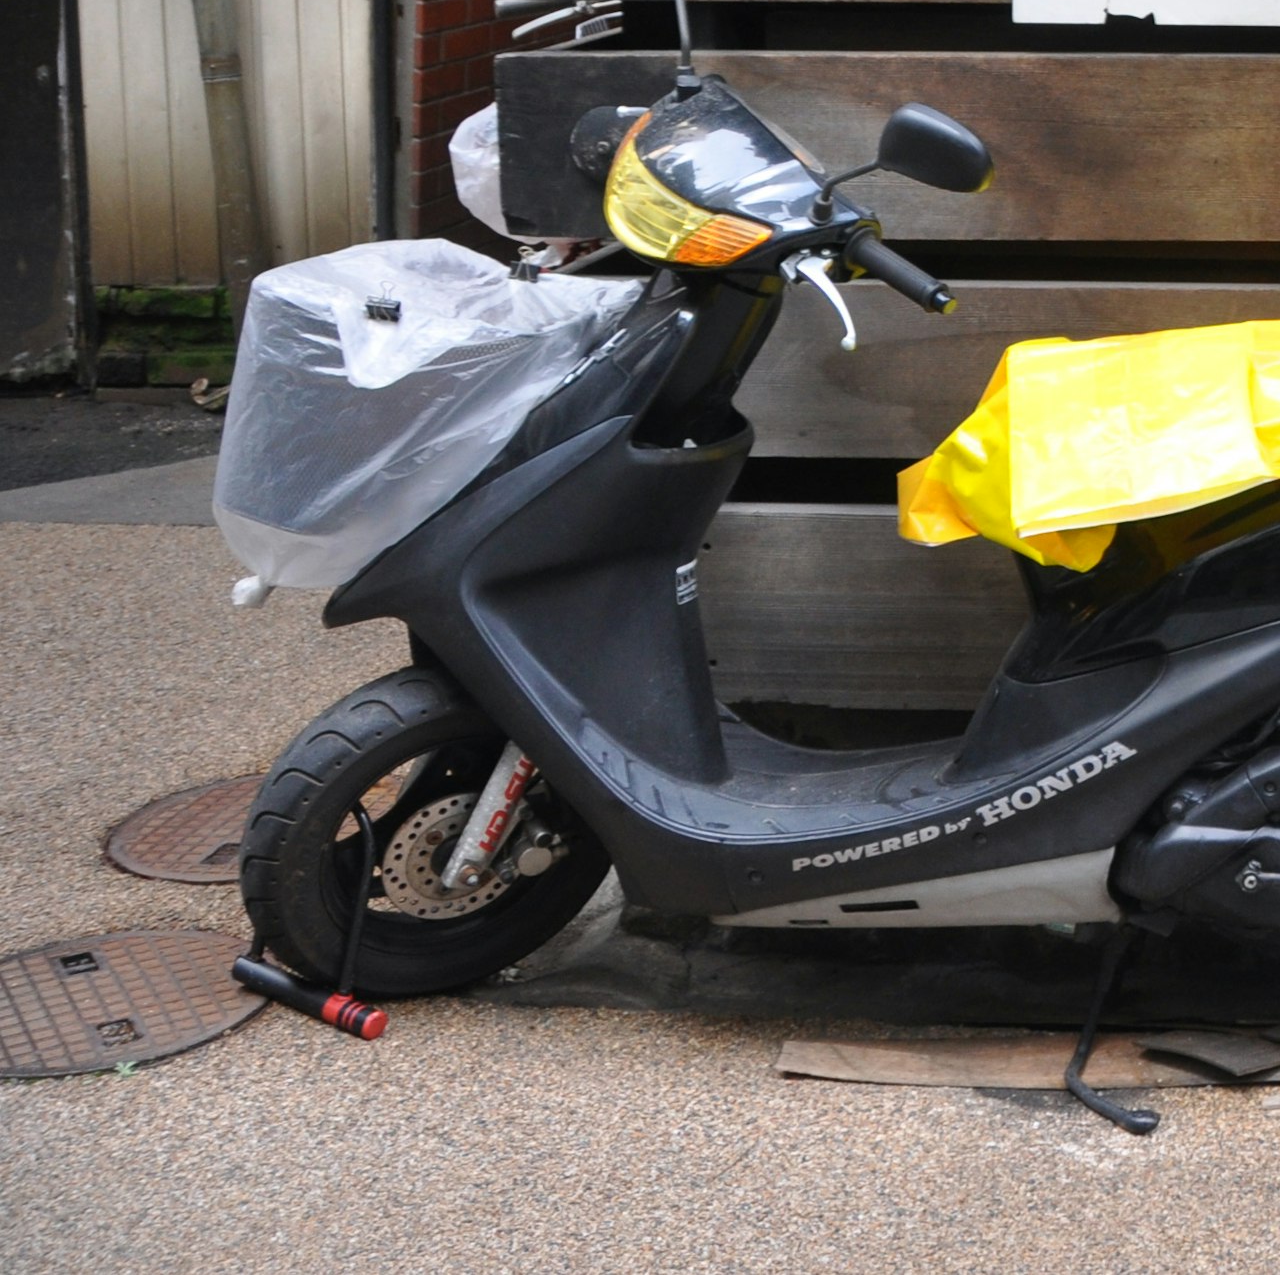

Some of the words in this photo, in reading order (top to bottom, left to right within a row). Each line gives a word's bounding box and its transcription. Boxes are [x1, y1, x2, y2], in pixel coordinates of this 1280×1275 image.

[791, 824, 941, 873] POWERED
[943, 816, 972, 836] by
[975, 740, 1139, 828] HONDA
